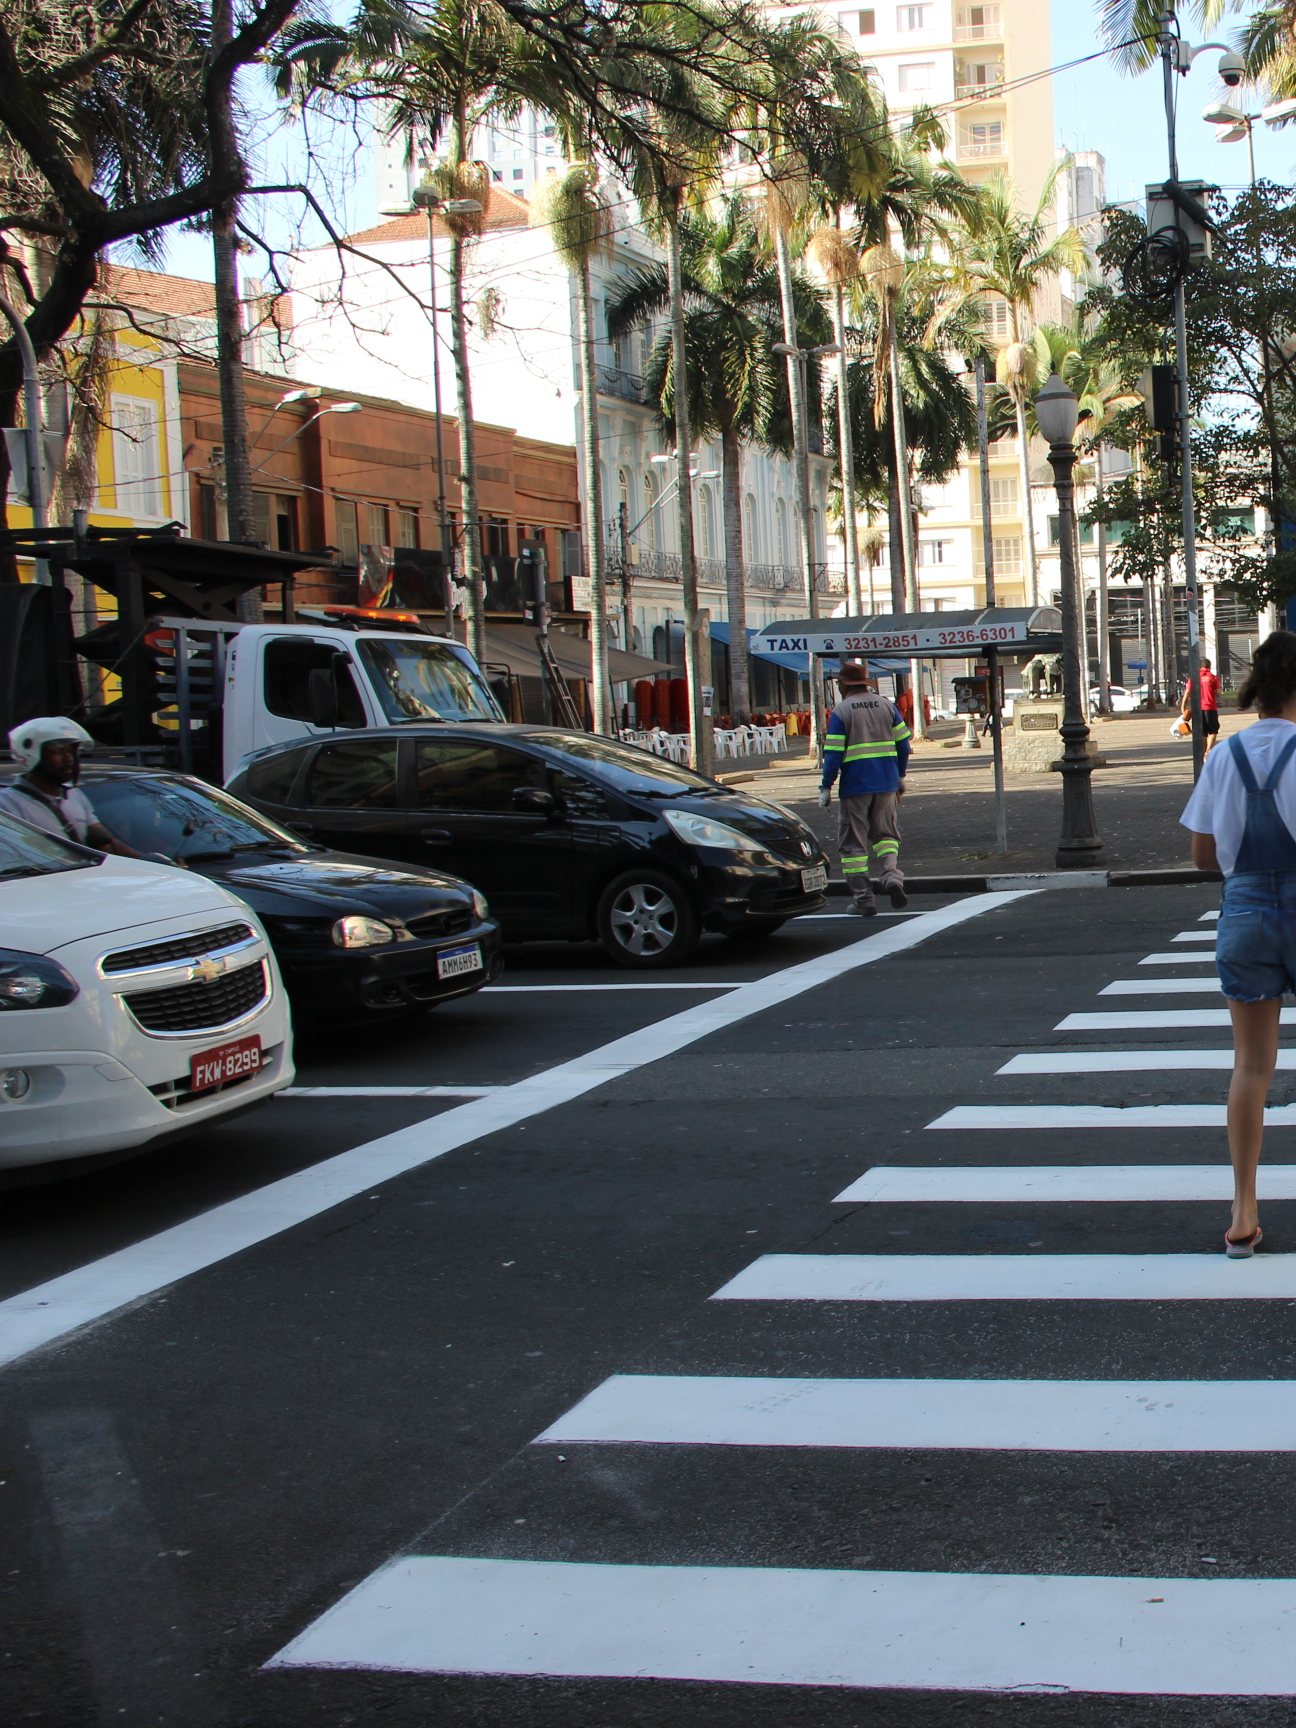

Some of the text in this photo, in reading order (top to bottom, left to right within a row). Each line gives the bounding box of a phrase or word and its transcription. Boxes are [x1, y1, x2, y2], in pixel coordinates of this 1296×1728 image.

[766, 638, 809, 651] TAXI
[844, 634, 919, 651] 3231-2851
[938, 626, 1016, 646] 3236-6301
[850, 700, 880, 710] EMDEC
